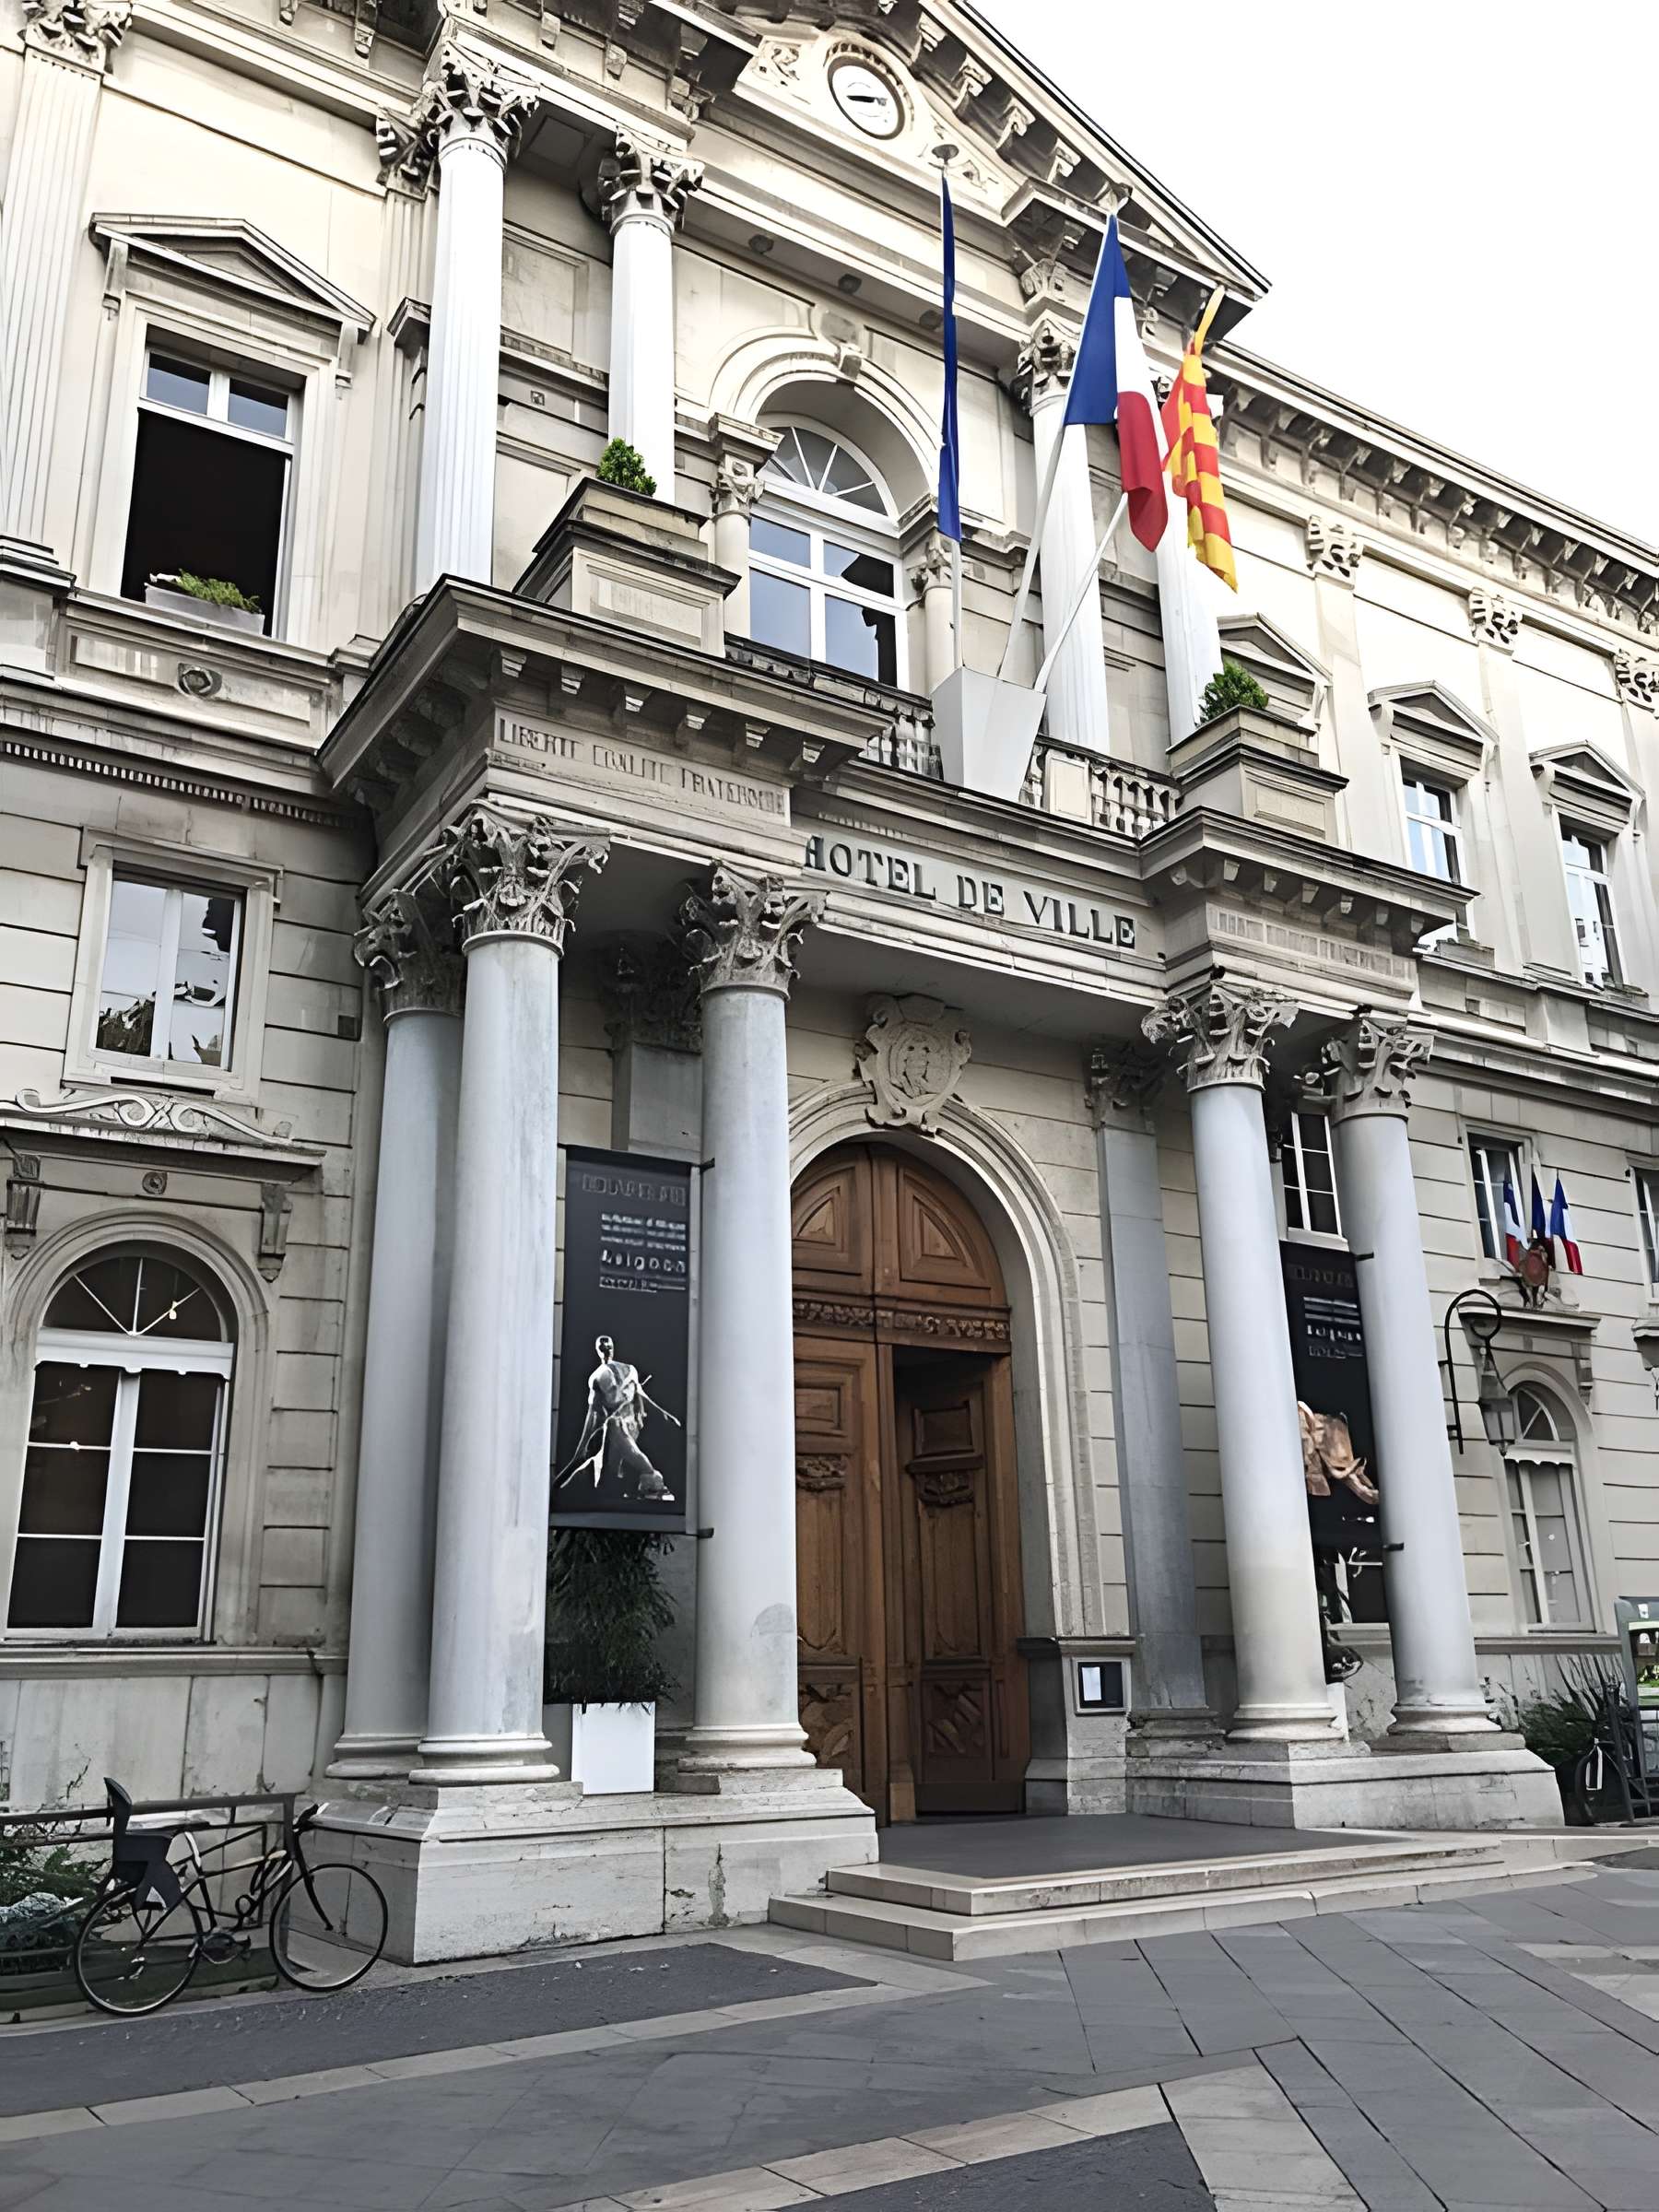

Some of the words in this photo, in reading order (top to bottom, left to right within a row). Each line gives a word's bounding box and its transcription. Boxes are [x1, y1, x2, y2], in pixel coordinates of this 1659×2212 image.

[804, 834, 936, 900] HOTEL
[957, 875, 1005, 914] DE
[1023, 890, 1135, 949] VILLE
